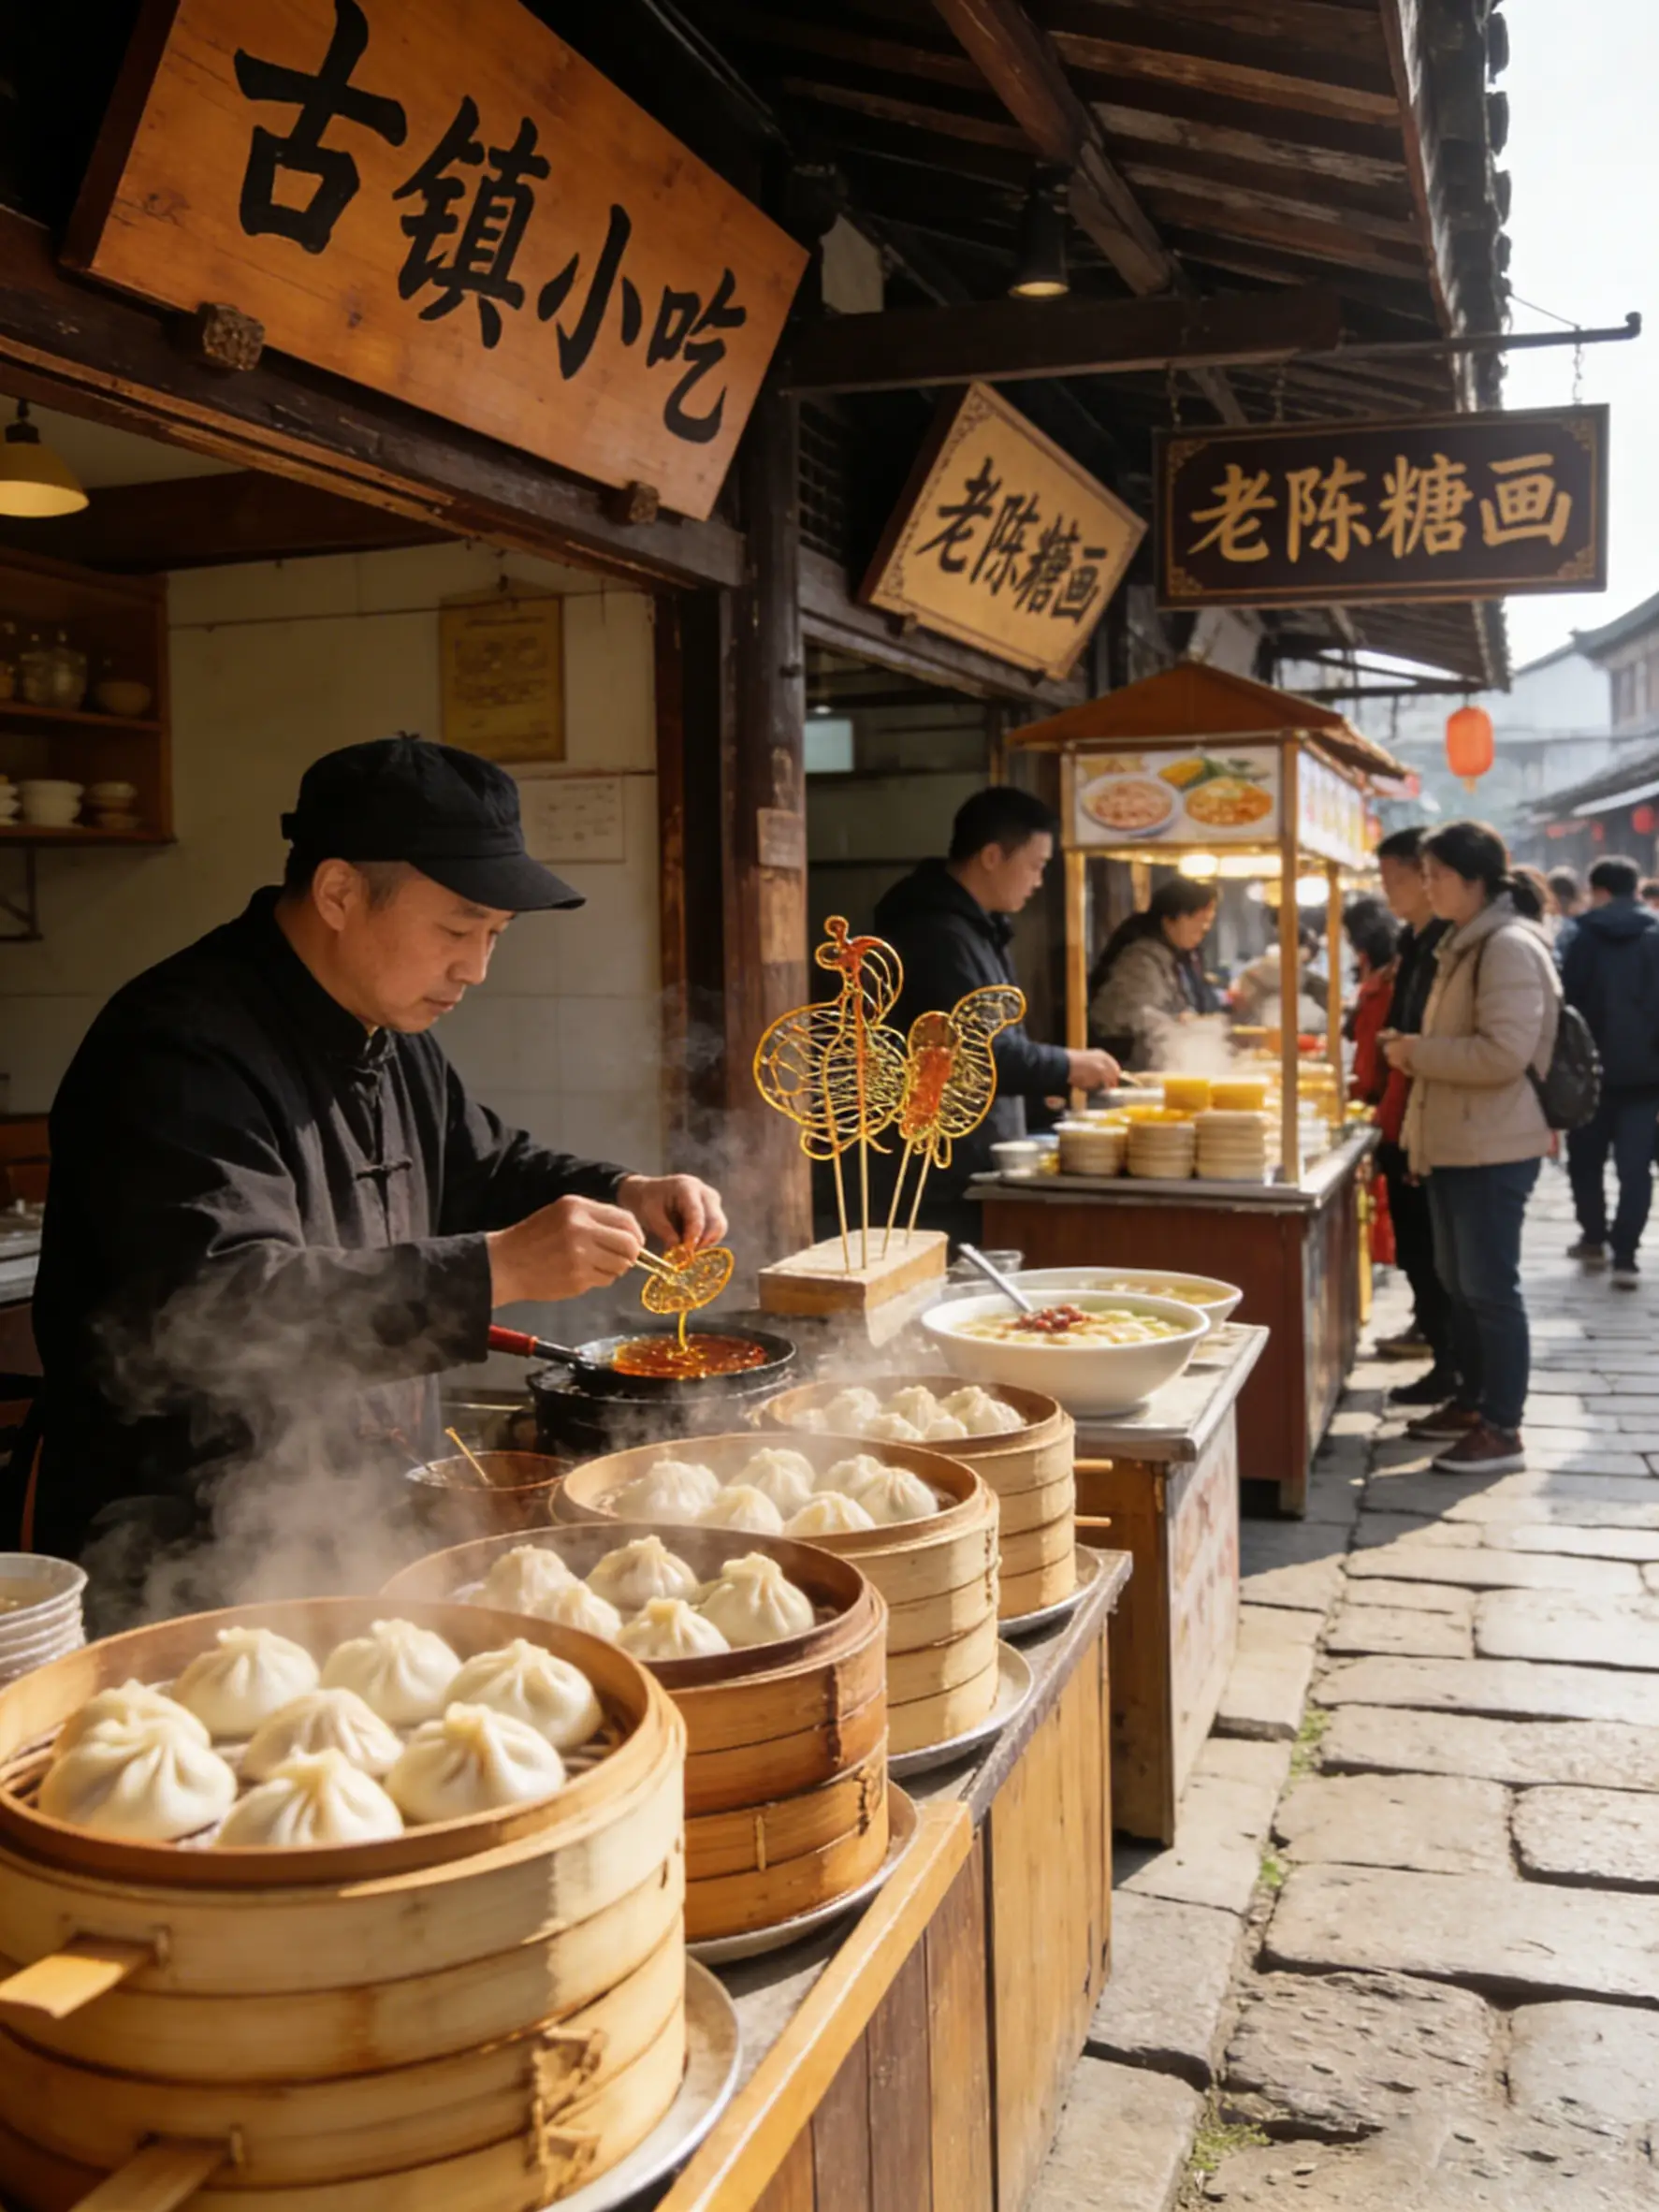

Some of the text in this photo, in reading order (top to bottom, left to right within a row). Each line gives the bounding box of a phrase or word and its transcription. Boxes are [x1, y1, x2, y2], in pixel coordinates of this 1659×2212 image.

[236, 1, 746, 443] 古镇小吃
[1188, 454, 1571, 563] 老陈糖画
